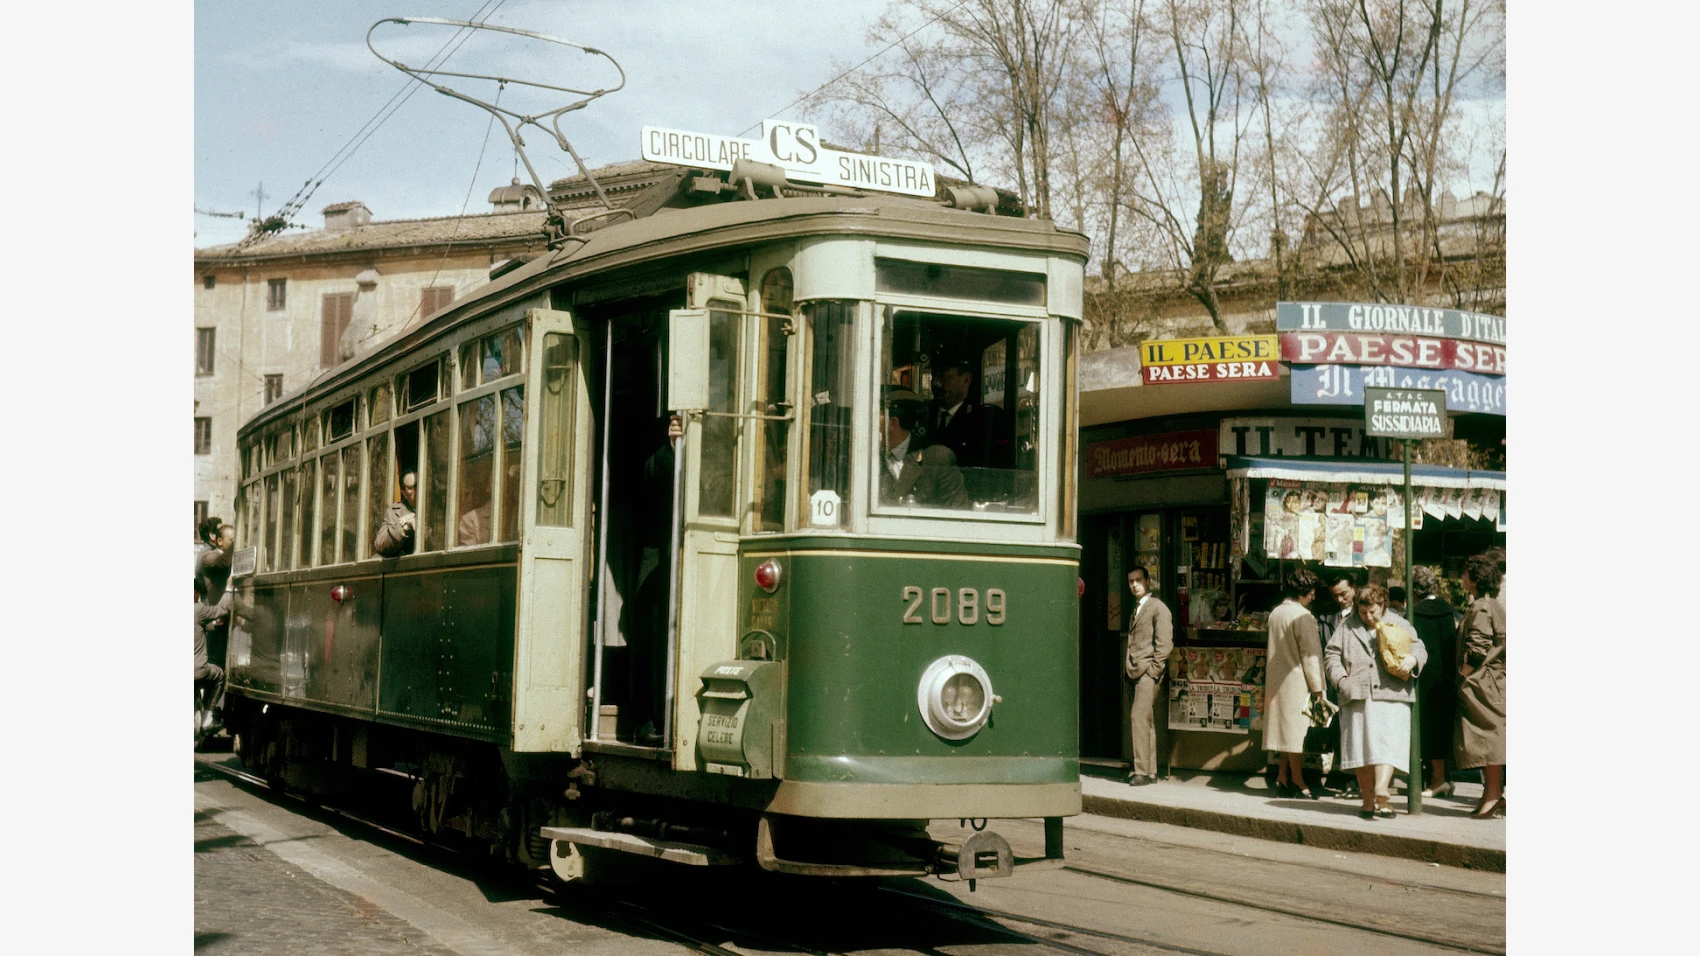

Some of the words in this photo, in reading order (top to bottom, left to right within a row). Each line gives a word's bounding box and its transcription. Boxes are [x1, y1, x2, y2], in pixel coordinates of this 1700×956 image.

[650, 130, 750, 165] CIRCOLARE
[770, 124, 817, 165] CS
[839, 156, 931, 192] SINISTRA
[1300, 305, 1327, 329] IL
[1349, 305, 1444, 334] GIORNALE
[1148, 344, 1174, 362] IL
[1183, 339, 1270, 360] PAESE
[1298, 334, 1442, 367] PAESE
[1149, 364, 1210, 381] PAESE
[1216, 361, 1272, 378] SERA
[1373, 399, 1438, 414] FERMATA
[1386, 392, 1425, 401] A.T.A.C.
[1371, 414, 1442, 433] SUSSIDIARIA
[1231, 426, 1283, 457] IL
[817, 499, 835, 516] 10
[903, 586, 1006, 625] 2089
[707, 715, 739, 729] SERVIZIO
[707, 730, 734, 745] CELERE
